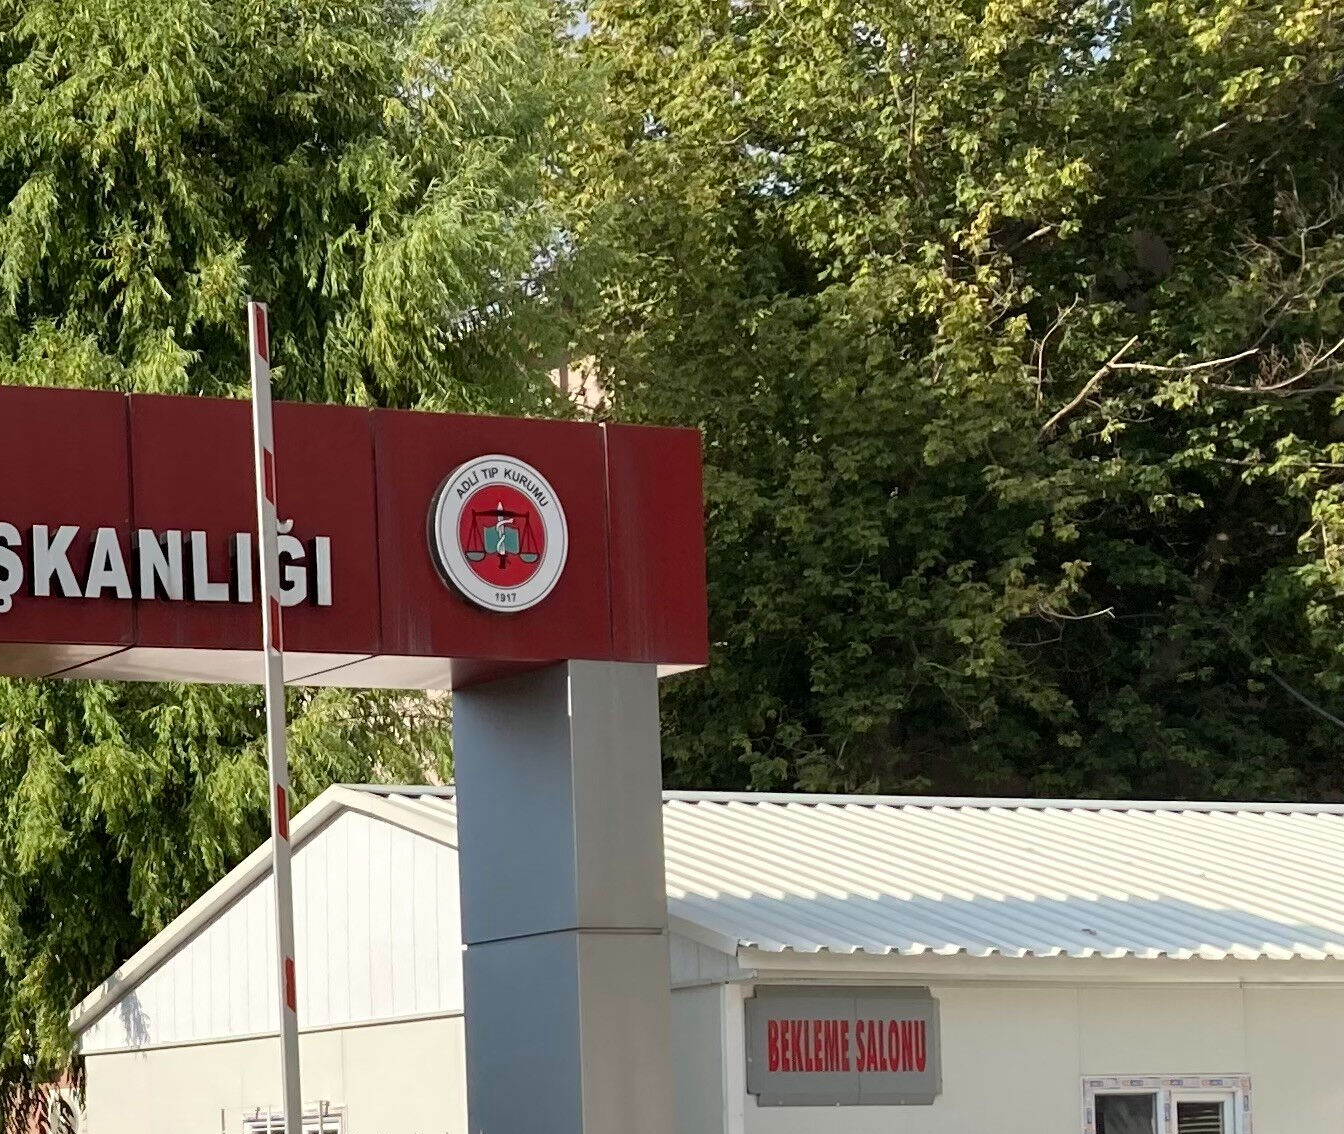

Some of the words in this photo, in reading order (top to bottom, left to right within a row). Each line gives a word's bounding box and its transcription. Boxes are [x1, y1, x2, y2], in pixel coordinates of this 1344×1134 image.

[456, 470, 479, 499] ADLİ
[481, 467, 499, 479] TIP
[503, 467, 549, 508] KURUMU
[495, 593, 517, 602] 1917
[767, 1019, 851, 1072] BEKLEME
[855, 1019, 927, 1072] SALONU
